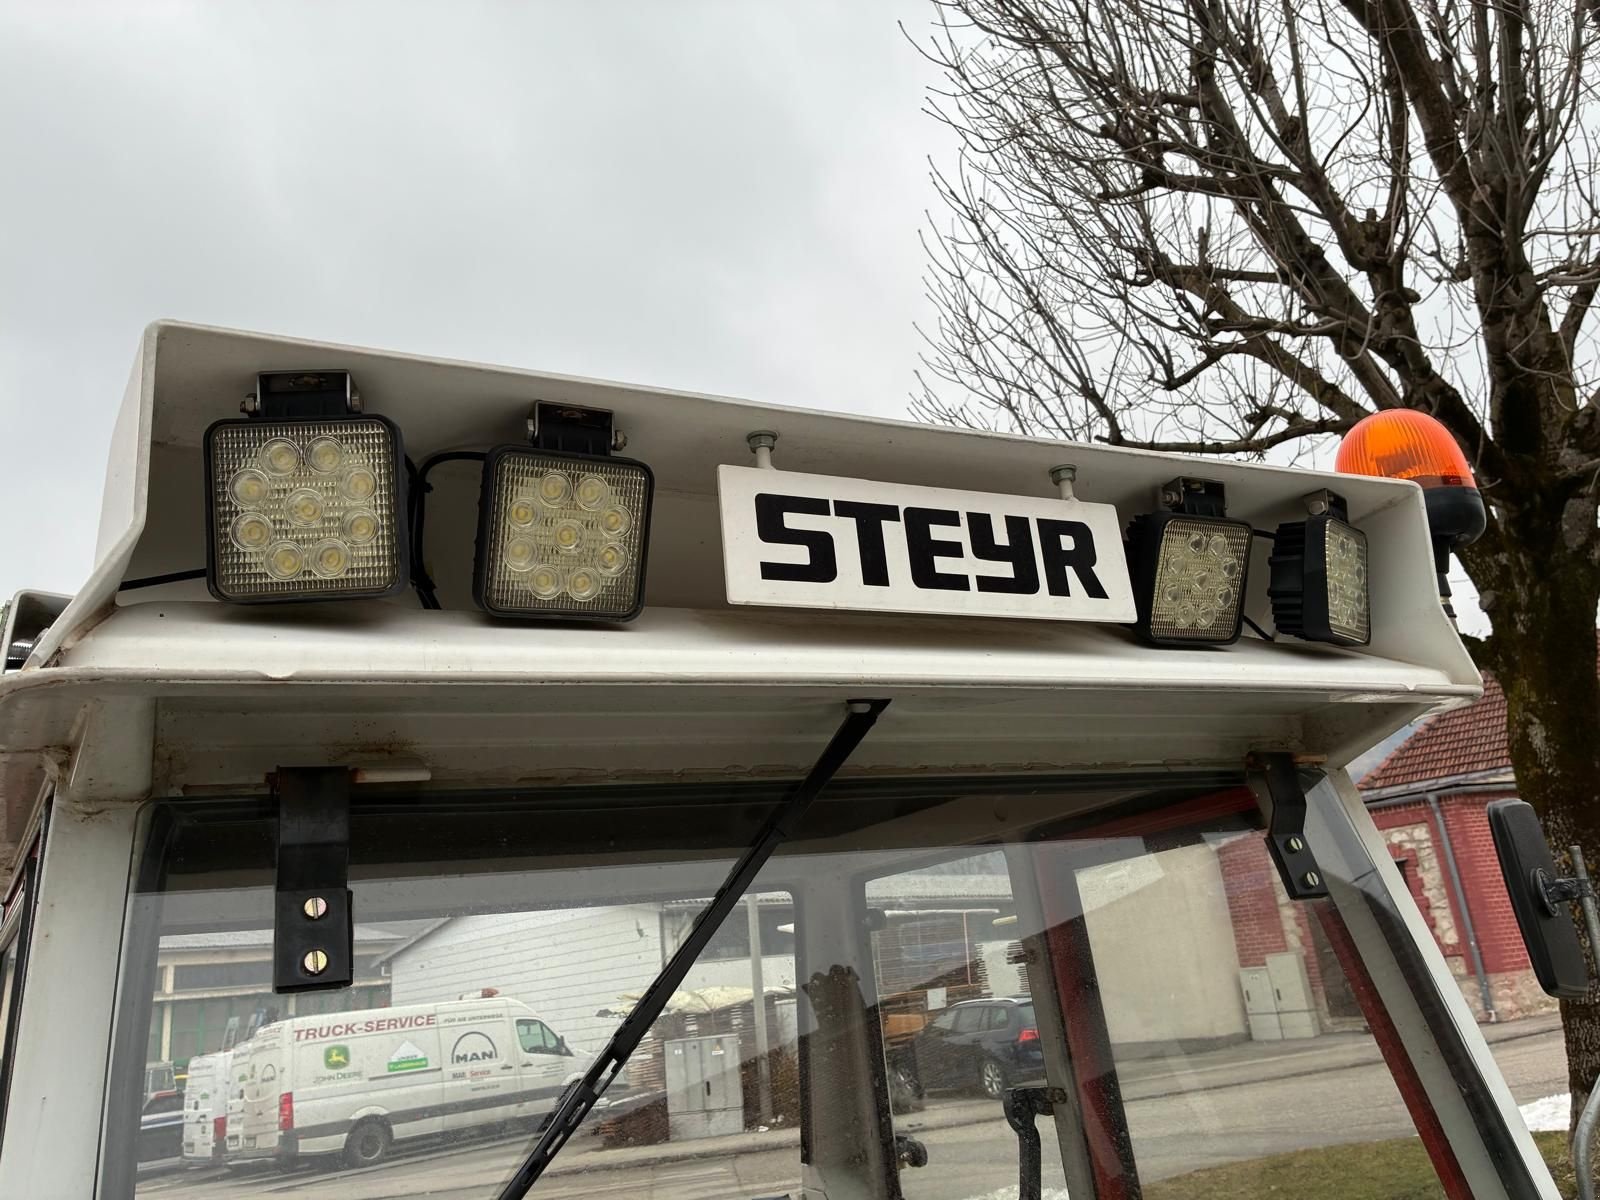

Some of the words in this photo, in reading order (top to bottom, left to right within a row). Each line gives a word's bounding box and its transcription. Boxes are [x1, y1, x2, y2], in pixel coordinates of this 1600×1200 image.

[755, 493, 1109, 600] STEYR
[294, 1014, 437, 1042] TRUCK-SERVICE
[455, 1050, 494, 1064] MAN
[313, 1073, 335, 1084] JOHN
[336, 1070, 363, 1081] DEERE
